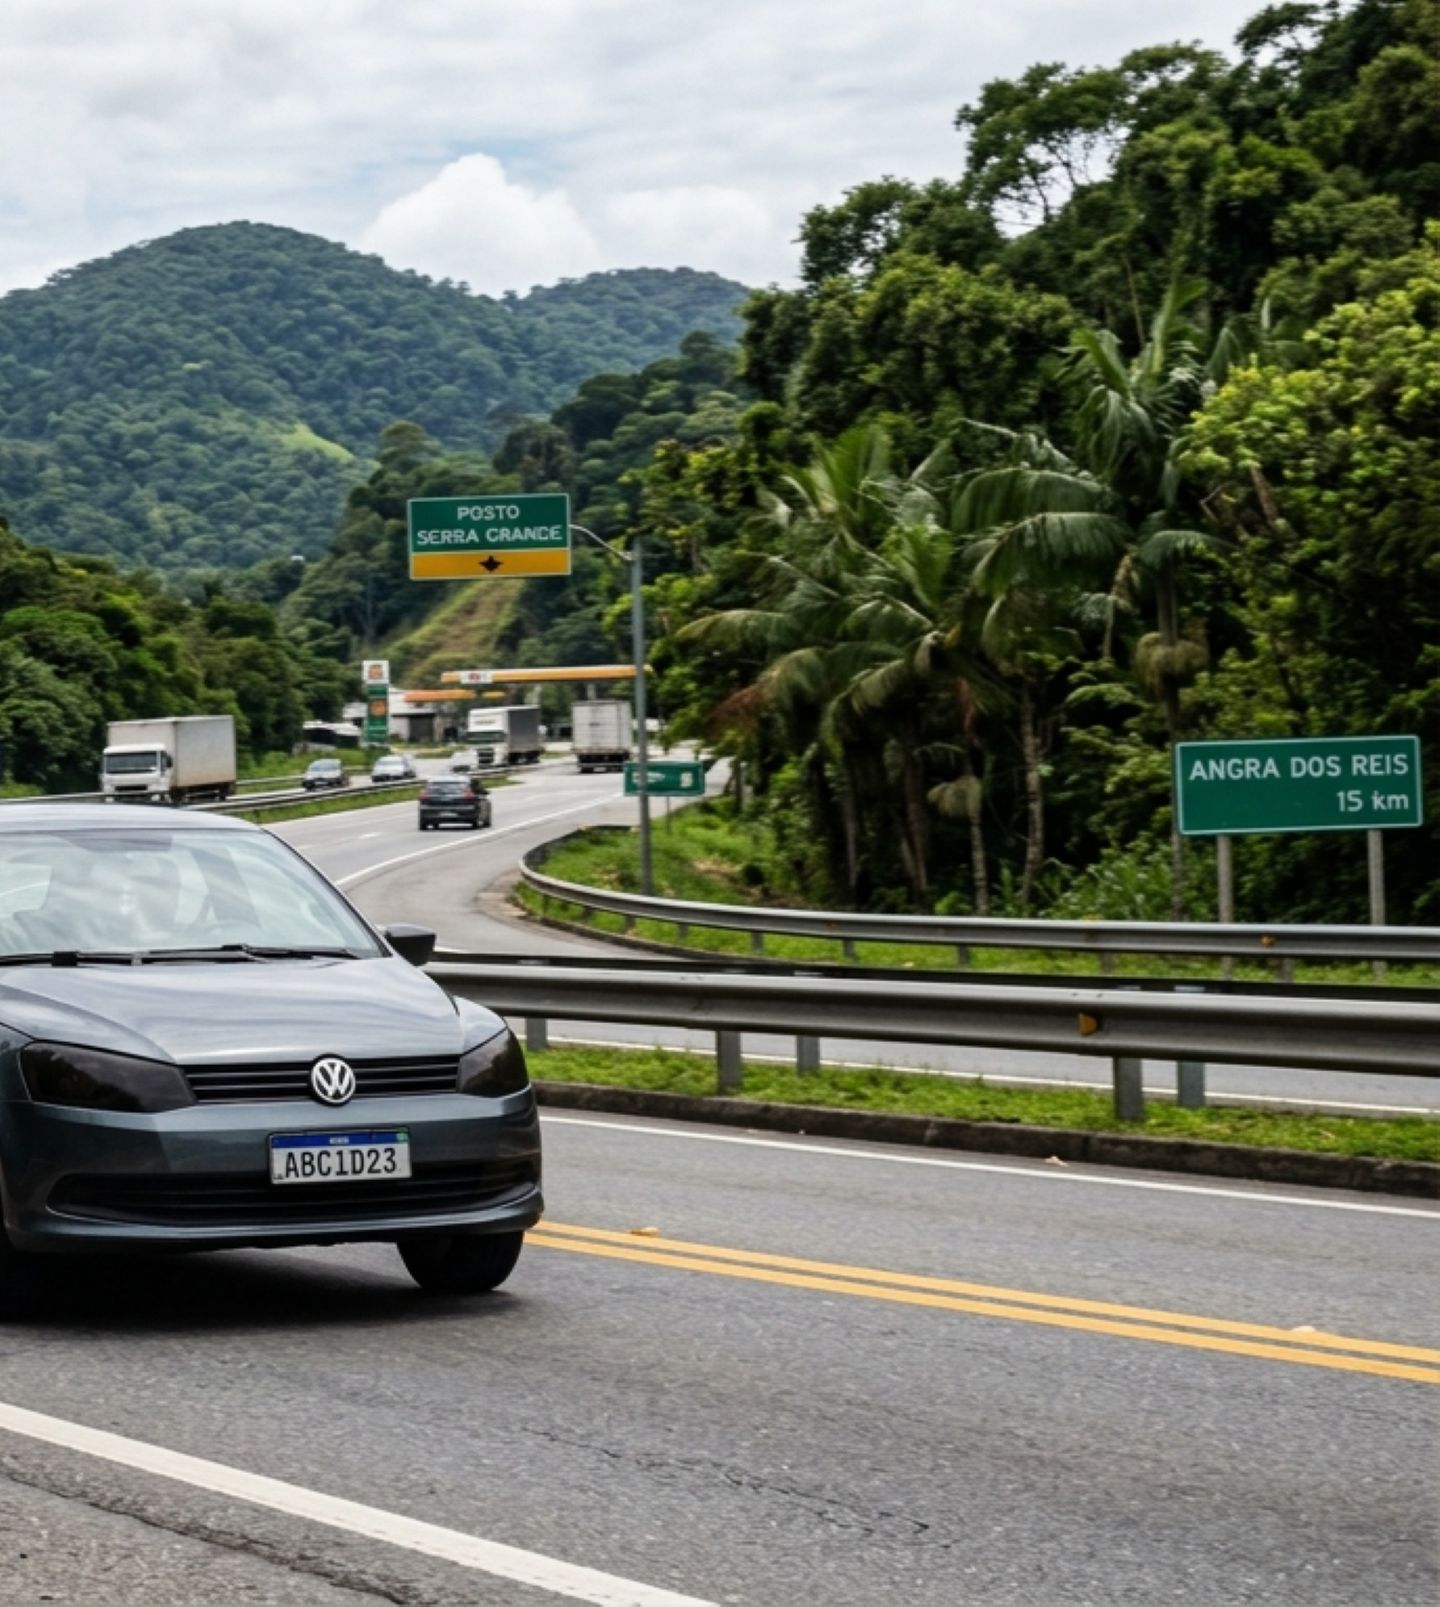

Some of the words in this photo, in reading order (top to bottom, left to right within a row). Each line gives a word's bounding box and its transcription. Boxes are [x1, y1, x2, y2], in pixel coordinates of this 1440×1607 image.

[457, 505, 520, 521] POSTO
[417, 528, 479, 545] SERRA
[1189, 758, 1280, 781] ANGRA
[1290, 756, 1342, 778] DOS
[1351, 753, 1409, 776] REIS
[1337, 790, 1363, 812] 15
[1371, 791, 1409, 811] km
[285, 1147, 397, 1179] ABC1D23
